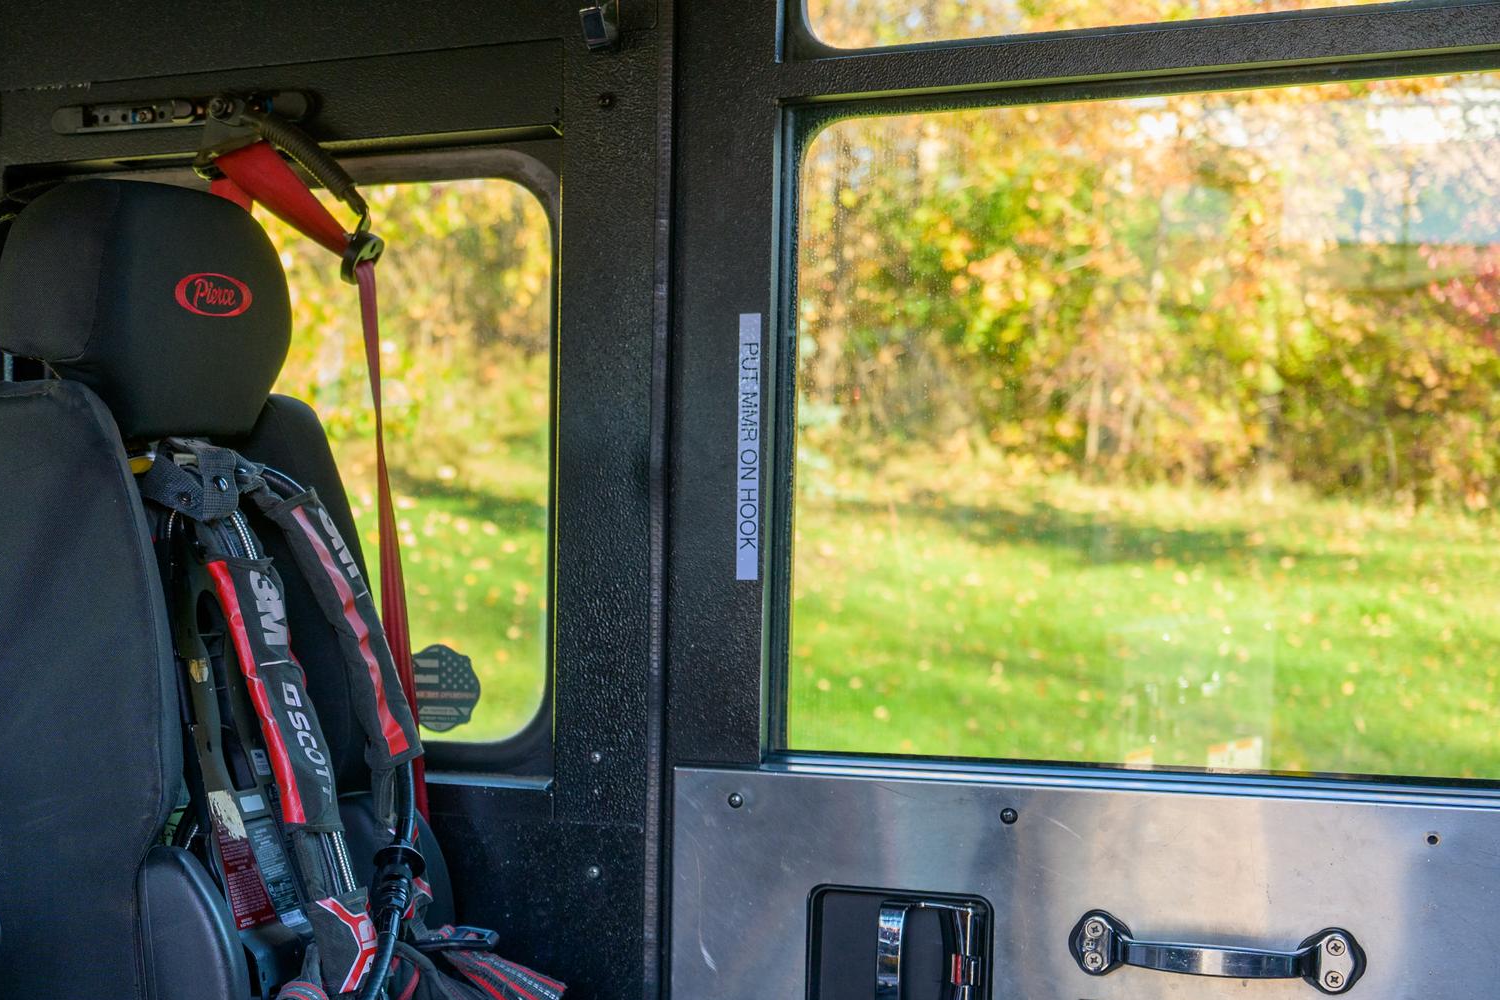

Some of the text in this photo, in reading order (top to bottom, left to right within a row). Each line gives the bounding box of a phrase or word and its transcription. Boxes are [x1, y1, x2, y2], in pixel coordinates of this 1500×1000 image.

[194, 278, 236, 307] Pierce
[741, 342, 759, 383] PUT
[740, 449, 757, 480] ON
[739, 488, 757, 550] HOOK
[250, 570, 289, 646] 3M
[288, 710, 333, 803] SCOTT
